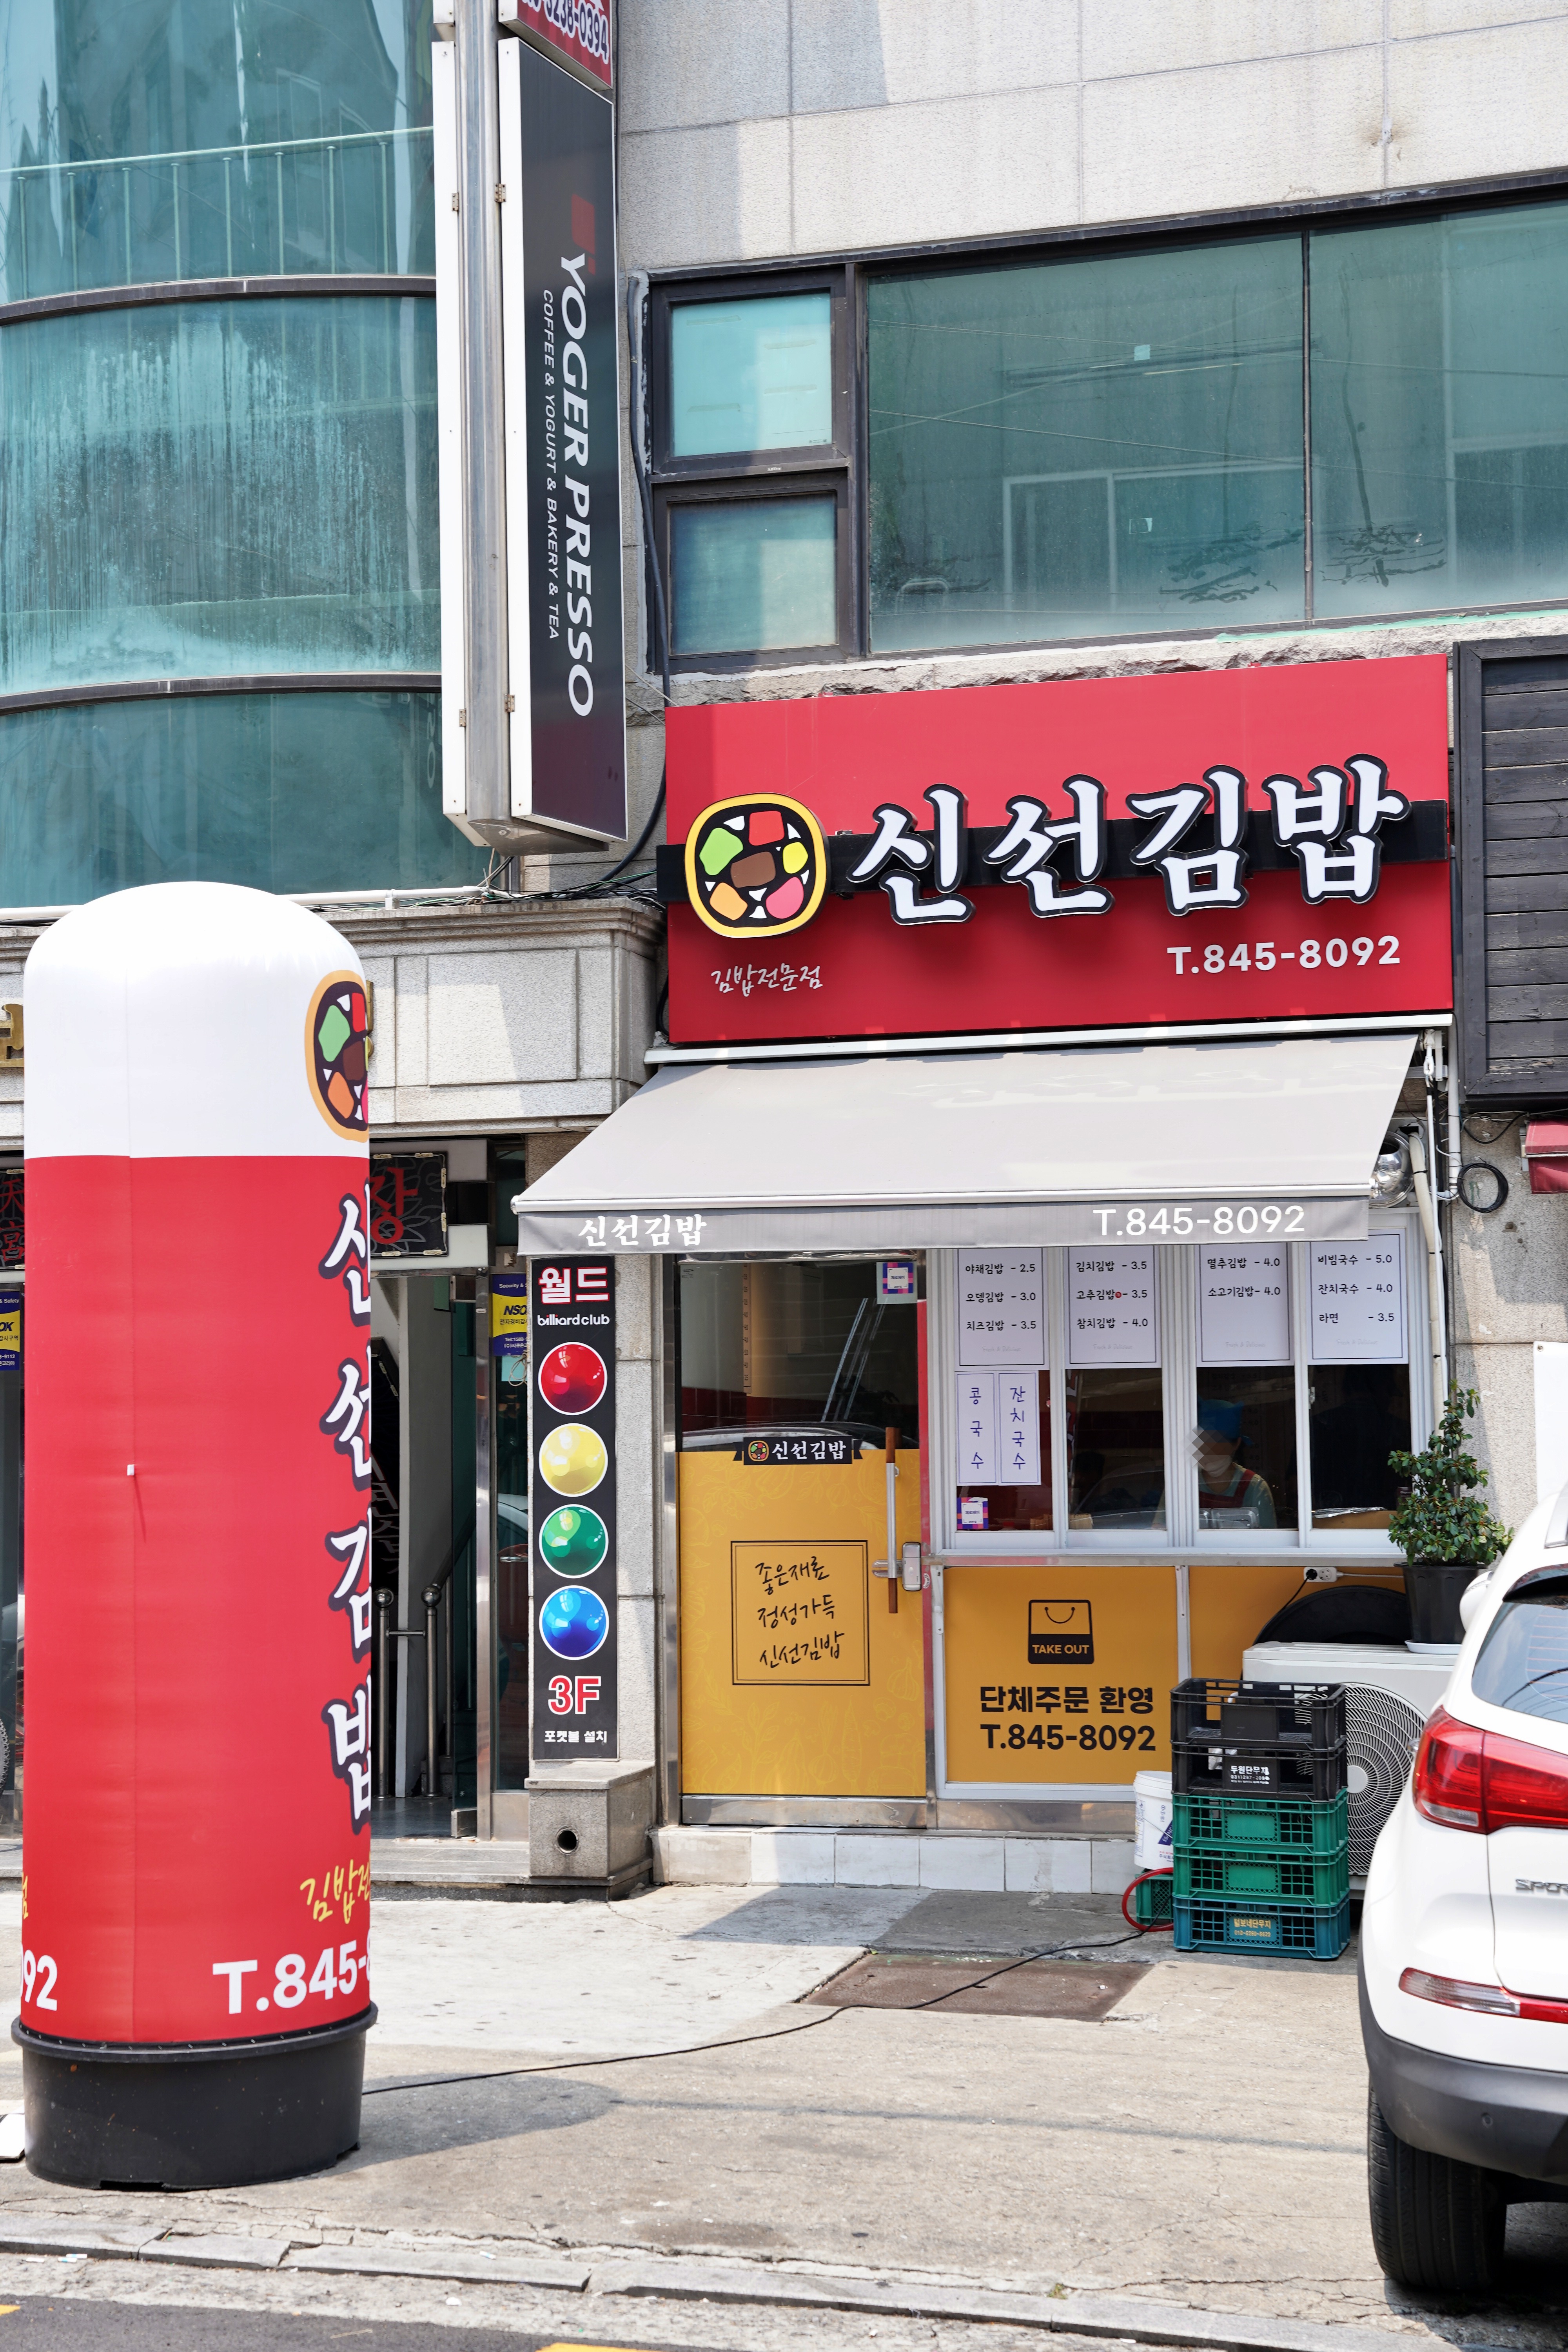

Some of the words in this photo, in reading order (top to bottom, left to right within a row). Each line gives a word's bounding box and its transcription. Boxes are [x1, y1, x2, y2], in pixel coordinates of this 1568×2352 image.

[543, 289, 555, 368] COFFEE
[561, 253, 589, 466] YOGER
[545, 372, 555, 386] &
[545, 395, 556, 474] YOGURT
[546, 477, 557, 491] &
[547, 497, 558, 579] BAKERY
[548, 582, 559, 595] &
[565, 474, 593, 717] PRESSO
[549, 604, 559, 639] TEA
[846, 753, 1411, 925] 신선김밥
[1167, 935, 1401, 975] T.845-8092
[711, 963, 823, 997] 김밥전문점
[578, 1214, 707, 1247] 신선김밥
[1093, 1205, 1305, 1236] T.845-8092
[965, 1263, 1004, 1274] 야채김밥
[1020, 1264, 1036, 1272] 2.5
[1076, 1261, 1115, 1272] 김치김밥
[1131, 1261, 1147, 1270] 3.5
[1207, 1257, 1247, 1269] 멸추김밥
[1263, 1258, 1280, 1267] 4.0
[1318, 1254, 1358, 1265] 비빔국수
[1376, 1254, 1392, 1263] 5.0
[538, 1267, 610, 1305] 월드
[965, 1292, 1004, 1303] 오뎅김밥
[1020, 1292, 1036, 1301] 3.0
[1076, 1289, 1115, 1300] 고추김밥
[1131, 1290, 1147, 1298] 3.5
[1207, 1286, 1254, 1297] 소고기김밥
[1264, 1287, 1280, 1296] 4.0
[1318, 1283, 1359, 1294] 잔치국수
[1376, 1284, 1392, 1292] 4.0
[537, 1314, 580, 1326] billiard
[581, 1314, 610, 1325] club
[966, 1320, 1004, 1331] 치즈김밥
[1020, 1321, 1036, 1329] 3.5
[1077, 1318, 1116, 1329] 참치김밥
[1132, 1318, 1148, 1327] 4.0
[1319, 1312, 1339, 1323] 라면
[1377, 1313, 1394, 1321] 3.5
[969, 1387, 984, 1469] 콩국수
[1009, 1385, 1026, 1470] 잔치국수
[771, 1440, 847, 1460] 신선김밥
[755, 1556, 830, 1595] 좋은재료
[757, 1594, 835, 1629] 정성가득
[759, 1630, 845, 1668] 신선김밥
[1032, 1644, 1062, 1654] TAKE
[1064, 1644, 1090, 1654] OUT
[548, 1675, 602, 1715] 3F
[980, 1686, 1089, 1713] 단체주문
[1099, 1686, 1153, 1714] 환영
[544, 1730, 580, 1743] 포켓볼
[584, 1730, 607, 1743] 설치
[980, 1724, 1156, 1751] T.845-8092
[299, 1851, 370, 1924] 김밥전
[21, 1944, 58, 2011] 92
